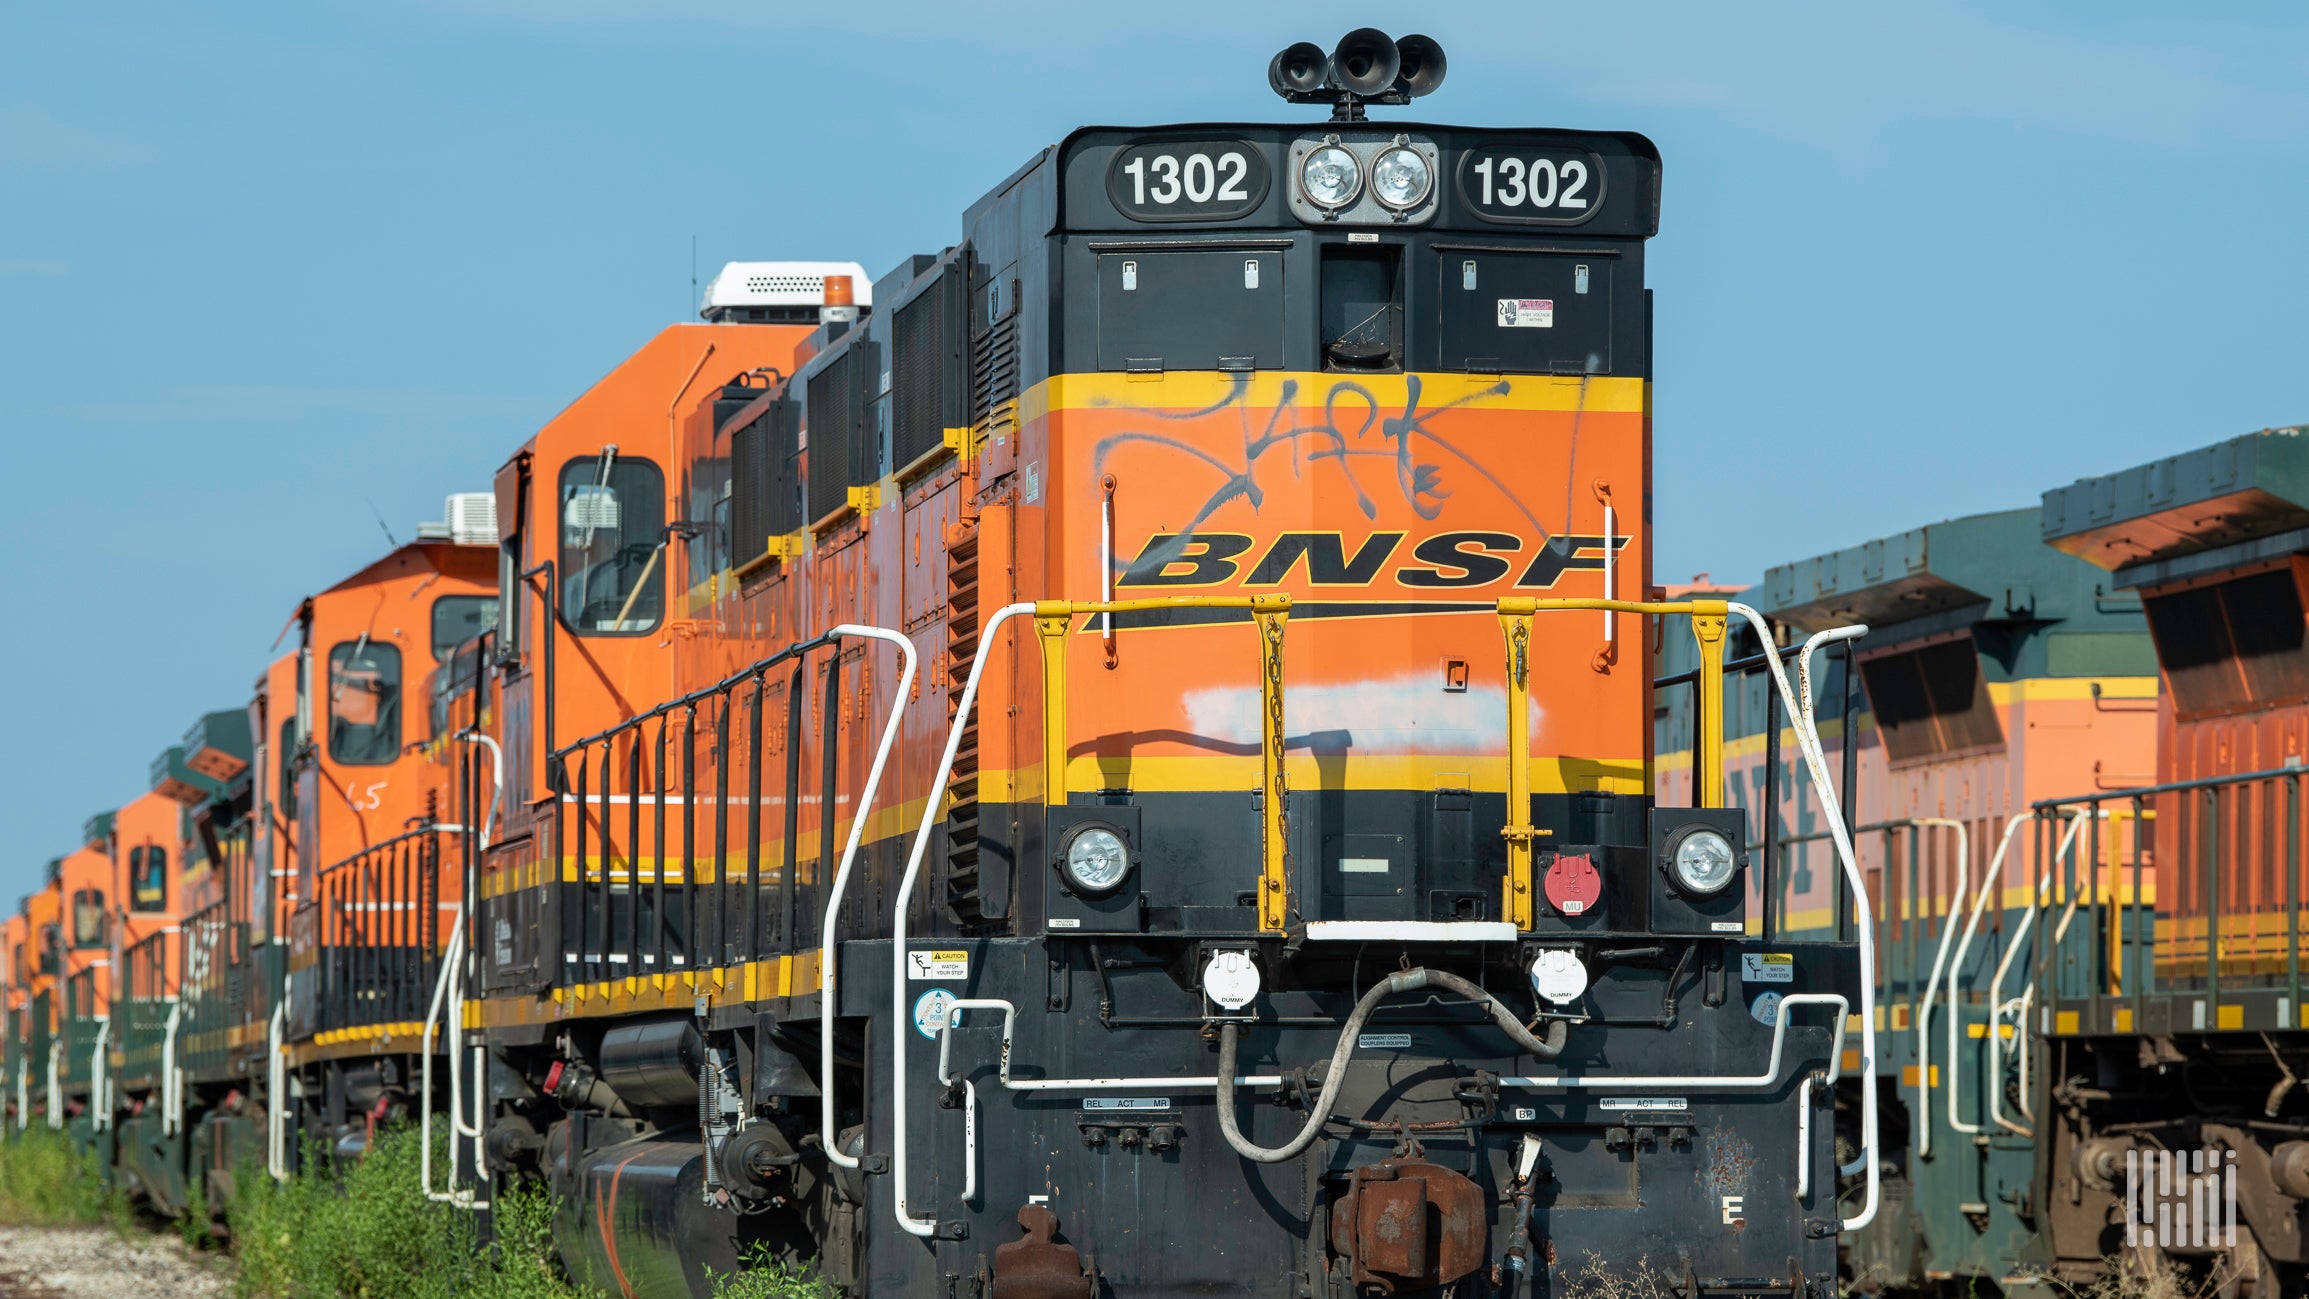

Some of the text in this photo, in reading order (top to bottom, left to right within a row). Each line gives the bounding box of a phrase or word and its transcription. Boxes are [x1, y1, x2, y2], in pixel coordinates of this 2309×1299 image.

[1124, 151, 1248, 205] 1302
[1474, 157, 1587, 209] 1302
[1115, 530, 1633, 590] BNSF
[1565, 902, 1581, 911] MU
[935, 1002, 942, 1014] 3
[1767, 1004, 1774, 1016] 3
[1086, 1100, 1103, 1108] REL
[1153, 1099, 1167, 1107] MR
[1667, 1100, 1684, 1108] REL
[1519, 1110, 1533, 1119] BP
[1722, 1196, 1744, 1225] E
